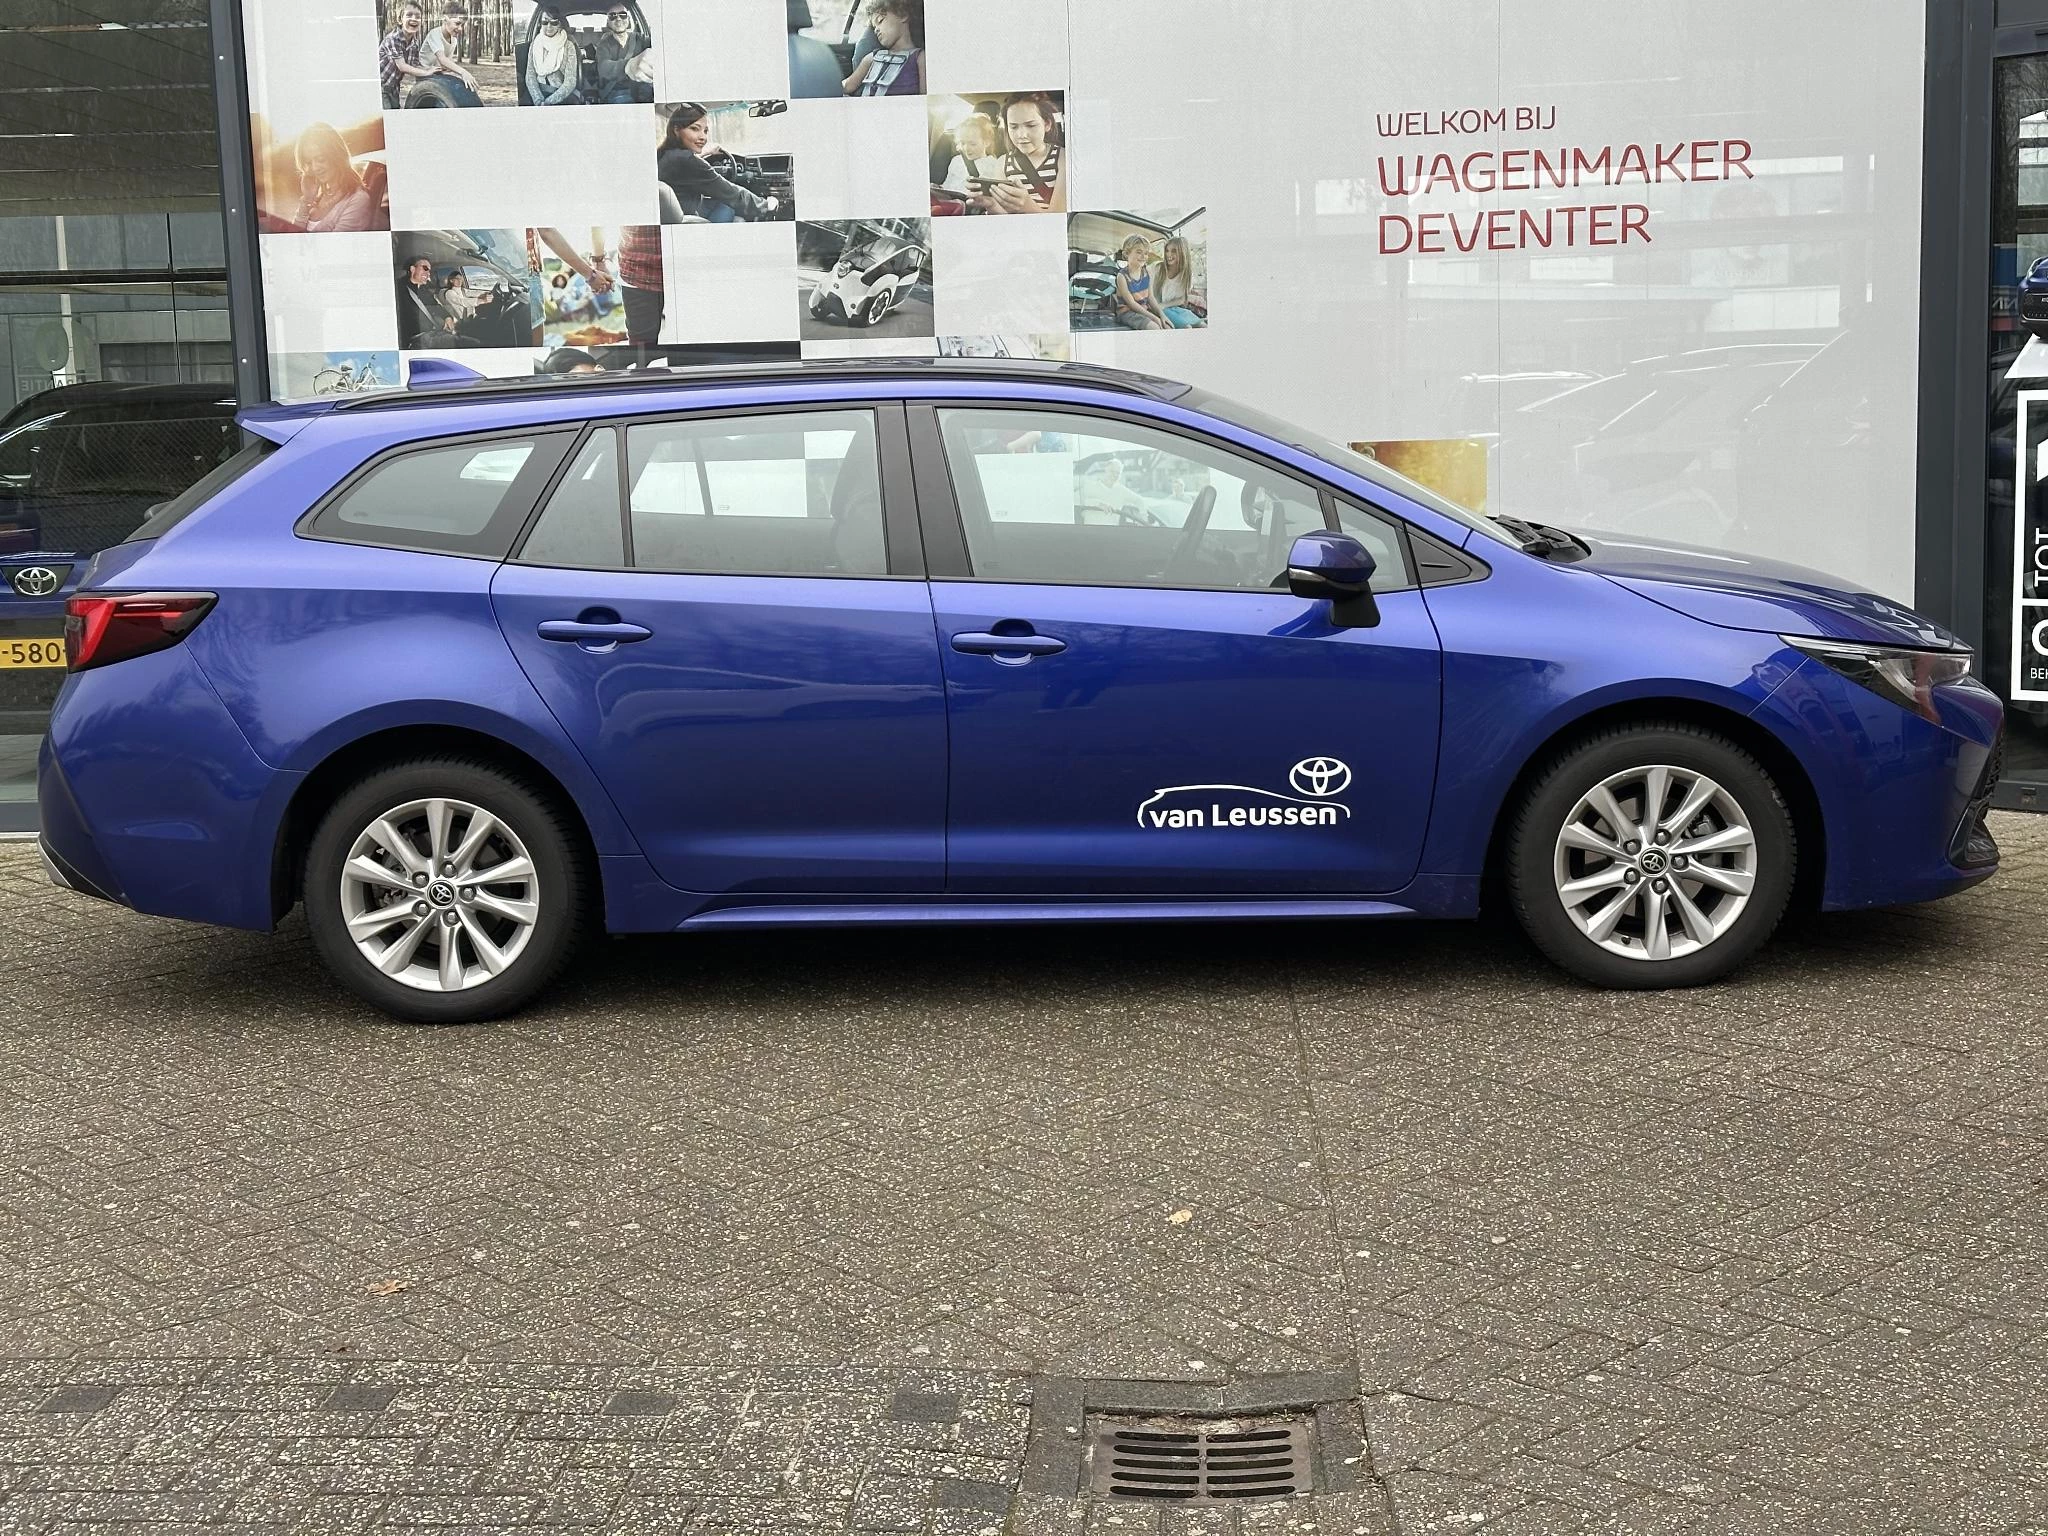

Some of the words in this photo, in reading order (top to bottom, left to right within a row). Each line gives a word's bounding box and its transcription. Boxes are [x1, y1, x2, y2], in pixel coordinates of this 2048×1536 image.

[1376, 107, 1506, 138] WELKOM
[1515, 105, 1556, 131] BIJ
[1377, 139, 1755, 197] WAGENMAKER
[1378, 203, 1653, 255] DEVENTER
[1149, 808, 1204, 828] van
[1212, 804, 1337, 827] Leussen
